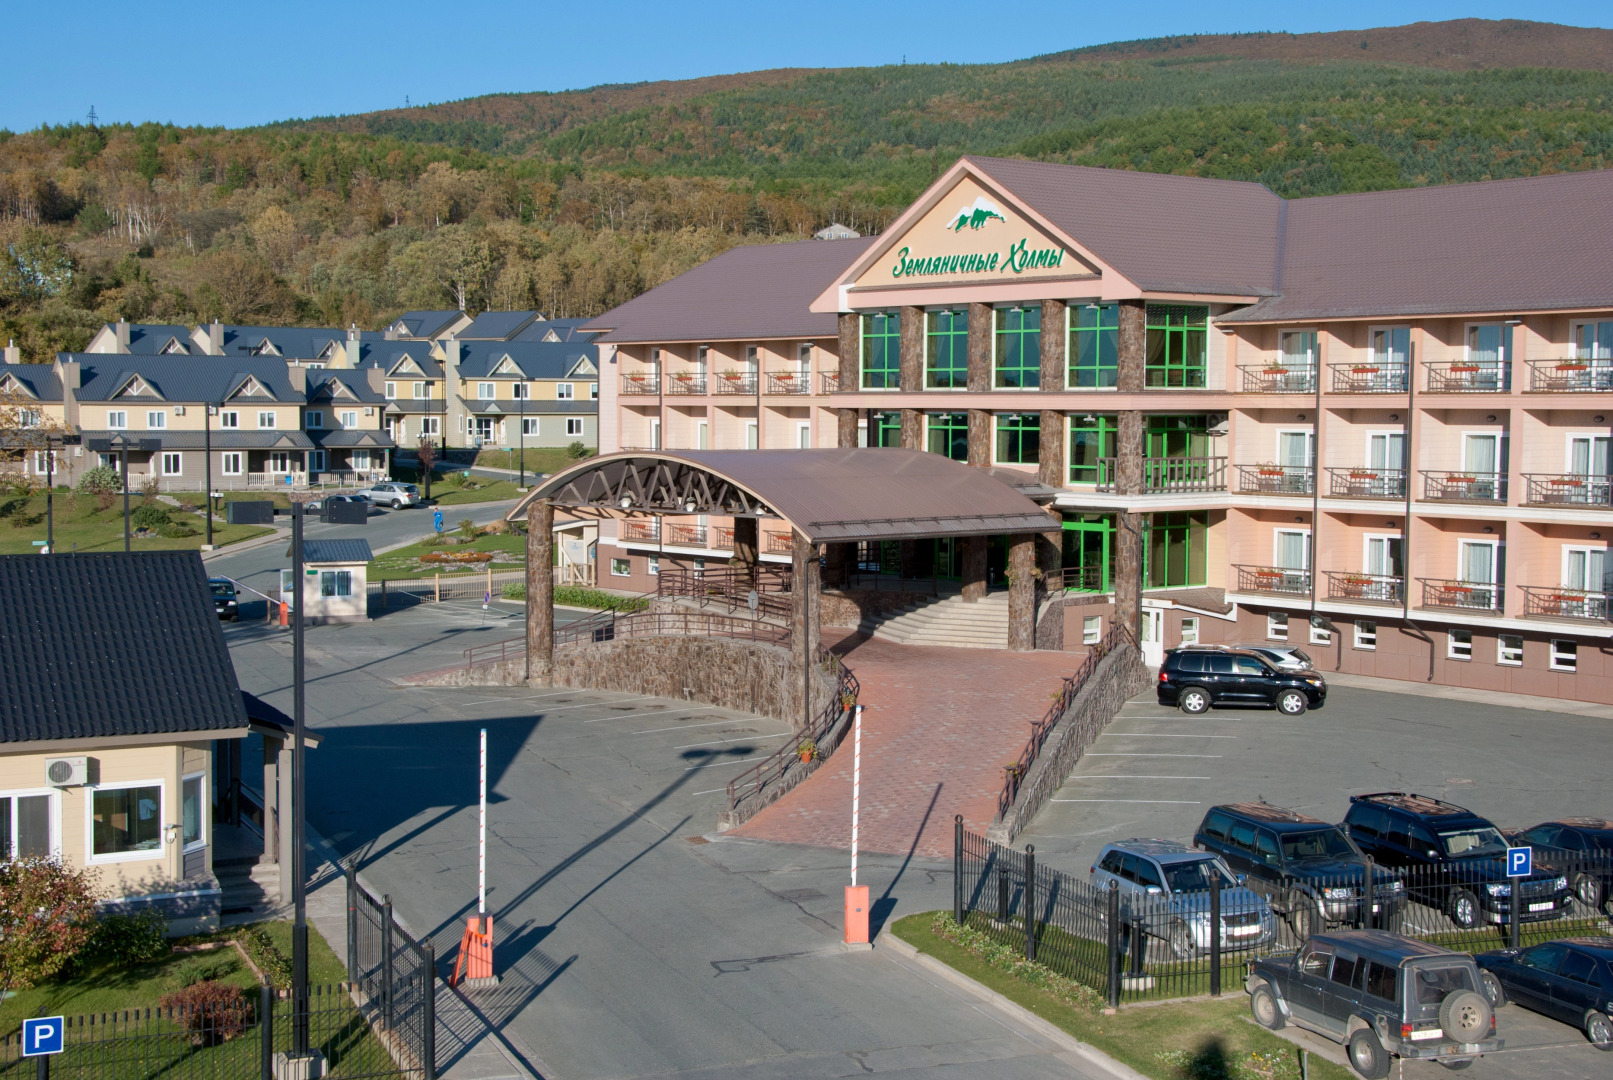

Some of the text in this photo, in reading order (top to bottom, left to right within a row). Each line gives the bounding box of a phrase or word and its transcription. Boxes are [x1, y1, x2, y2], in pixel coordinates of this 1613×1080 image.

[893, 238, 1065, 277] Земляничные Холмы
[1513, 852, 1526, 871] P
[34, 1024, 55, 1049] P
